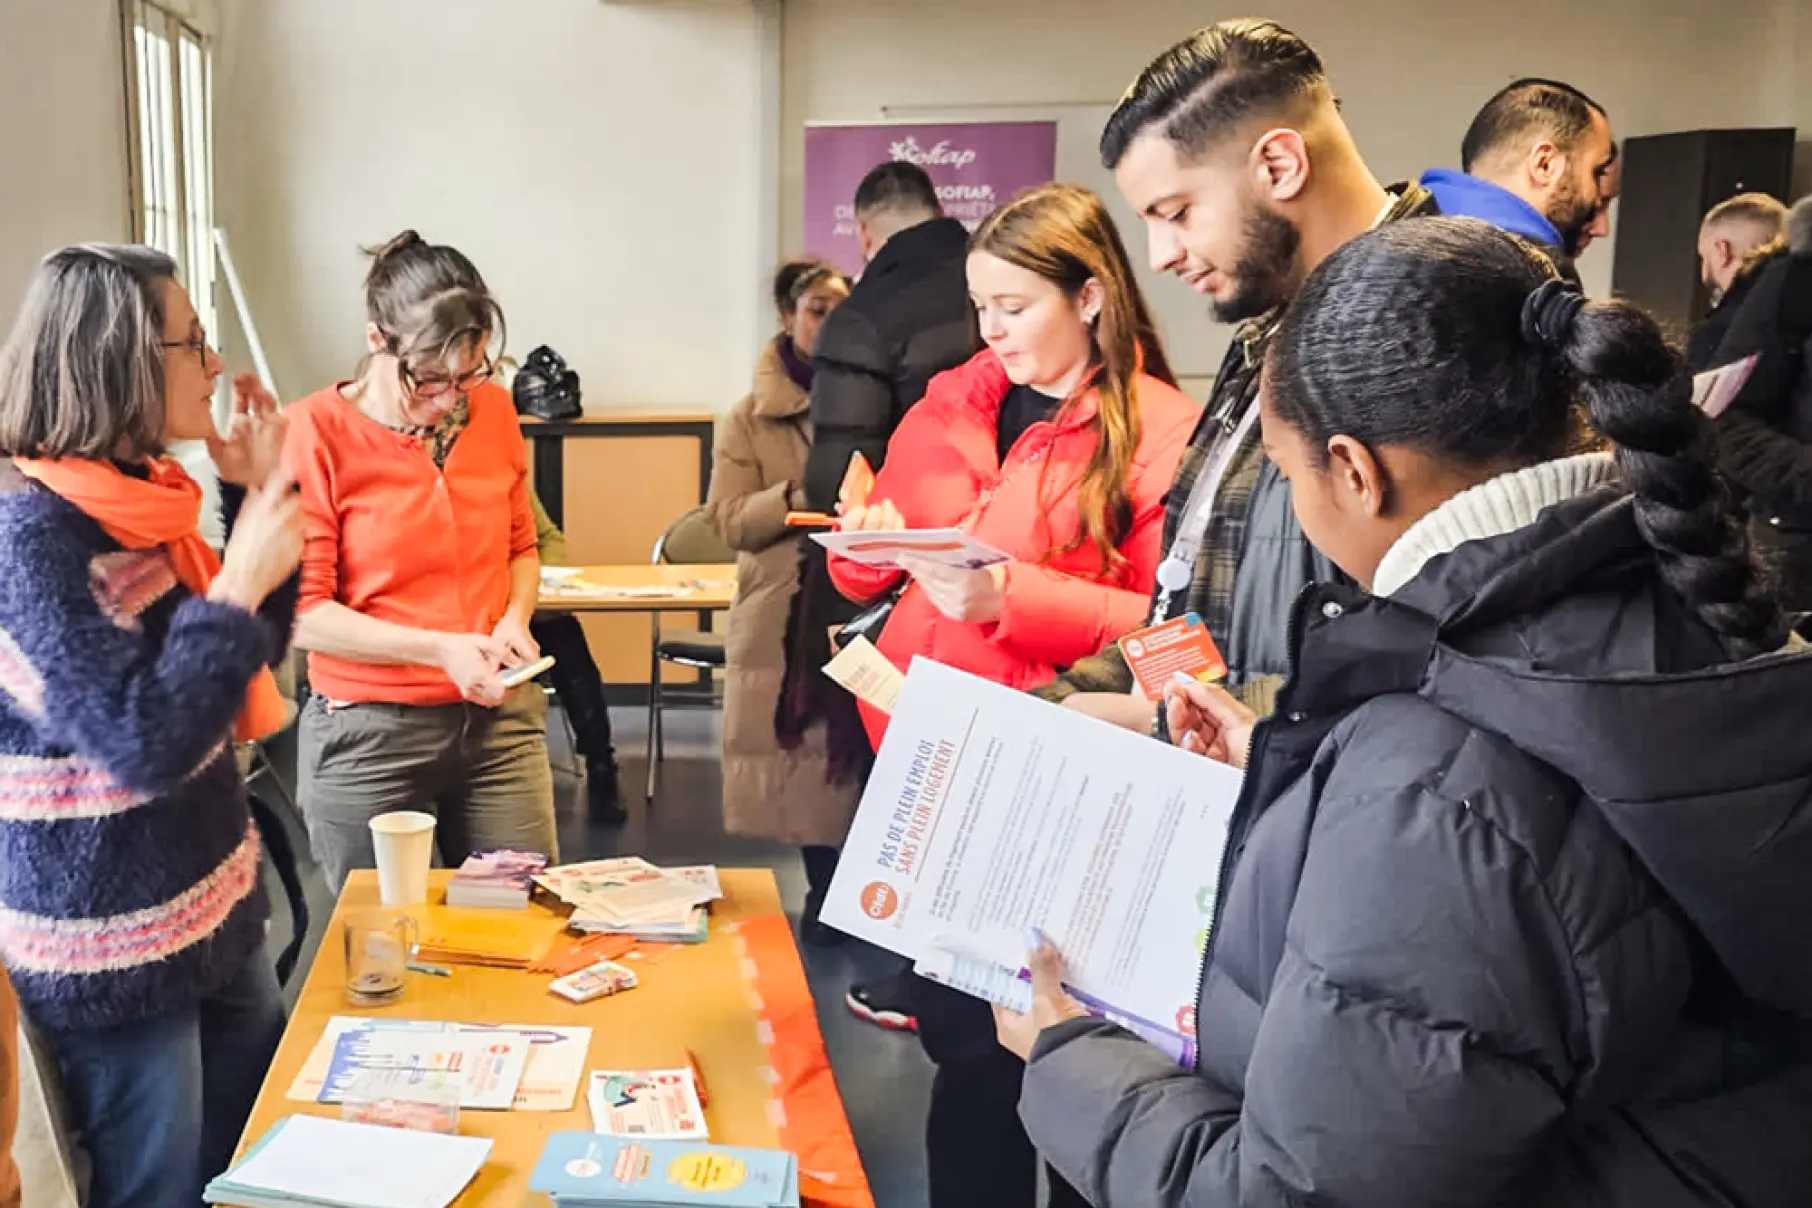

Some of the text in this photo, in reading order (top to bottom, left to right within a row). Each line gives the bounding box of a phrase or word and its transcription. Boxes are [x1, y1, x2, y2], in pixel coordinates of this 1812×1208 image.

[892, 785, 917, 824] PLEIN
[894, 841, 918, 876] SANS
[907, 803, 932, 842] PLEIN
[920, 739, 956, 804] LOGEMENT
[887, 823, 905, 842] DE
[877, 842, 897, 869] PAS
